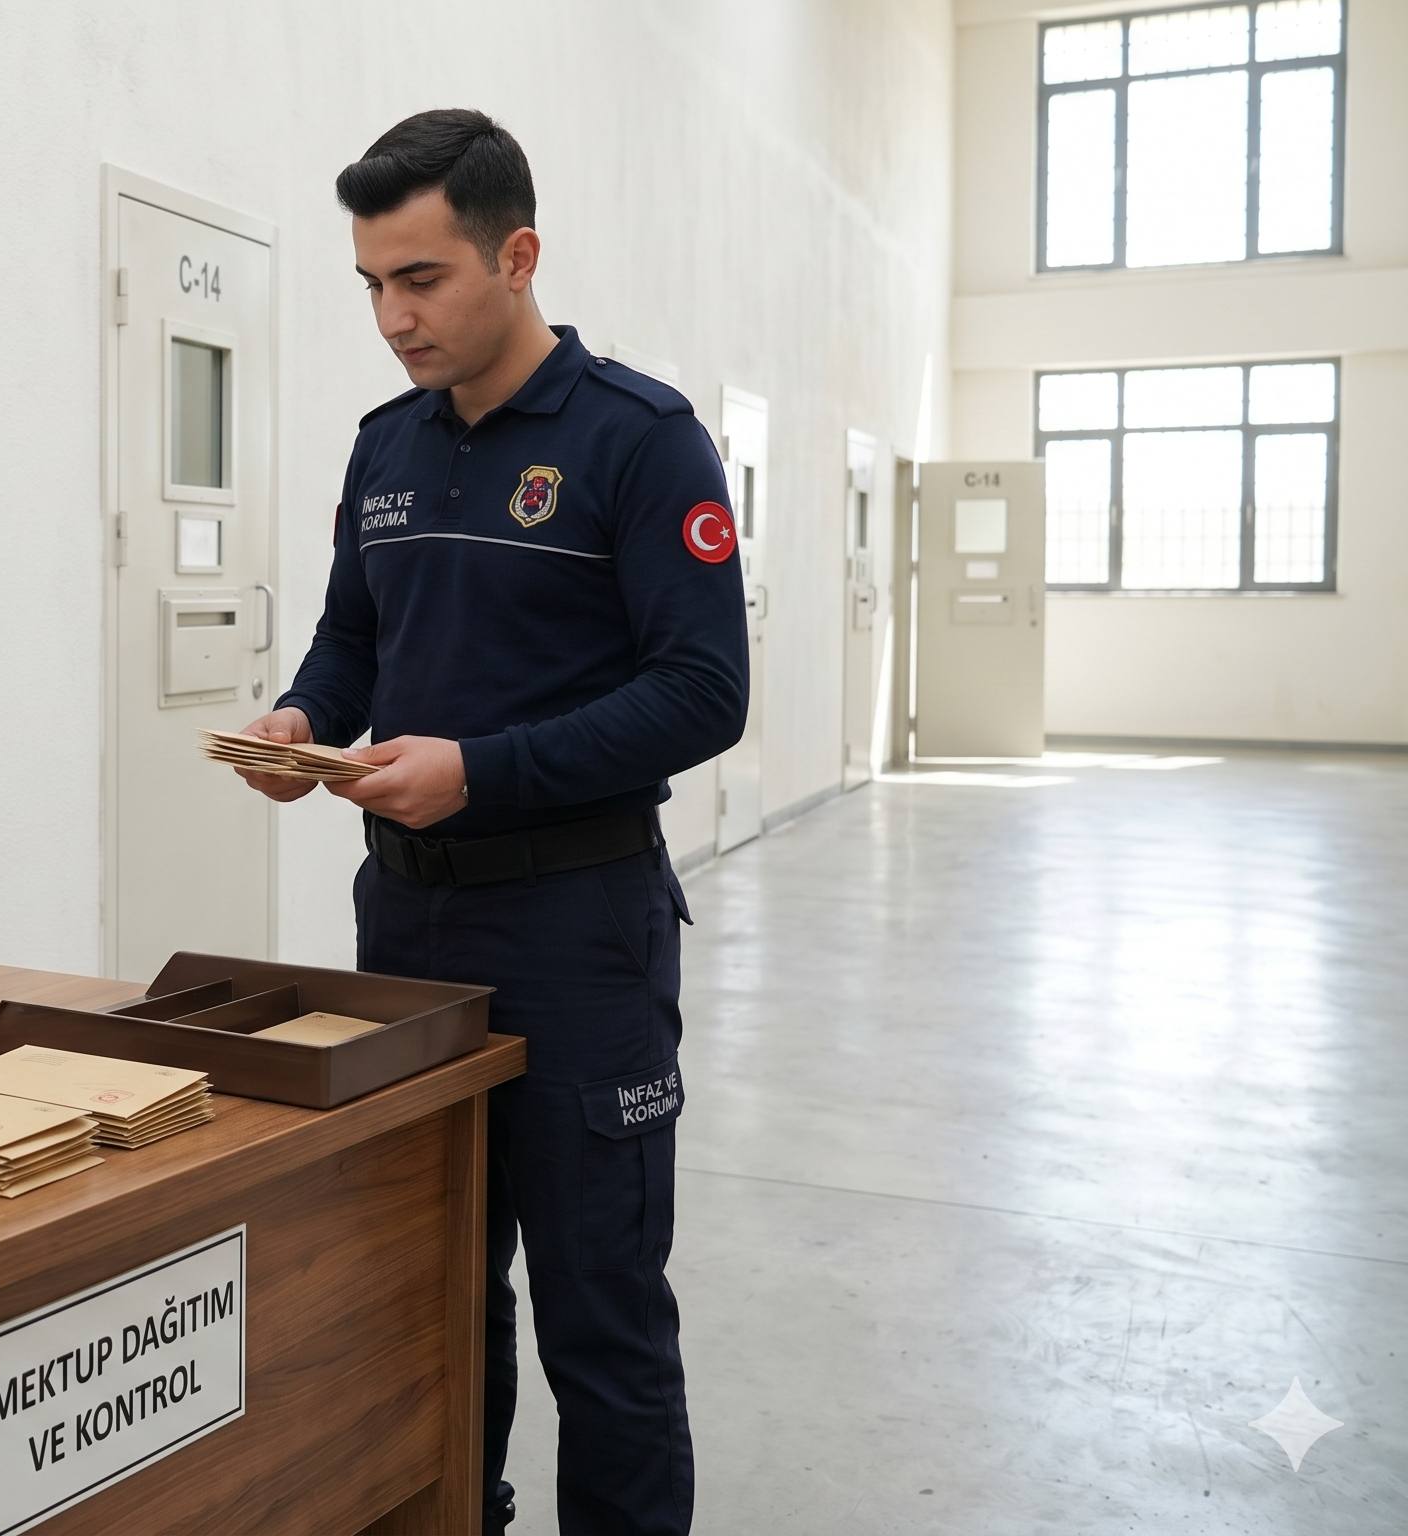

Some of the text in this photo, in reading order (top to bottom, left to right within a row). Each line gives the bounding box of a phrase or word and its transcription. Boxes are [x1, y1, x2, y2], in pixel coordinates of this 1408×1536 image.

[179, 254, 221, 302] C-14
[964, 471, 1001, 488] C-14
[361, 510, 408, 532] KORUMA
[362, 491, 415, 515] İNFAZ VE
[617, 1071, 678, 1108] İNFAZ VE
[122, 1280, 234, 1364] DAĞITIM
[28, 1359, 202, 1472] VE KONTROL
